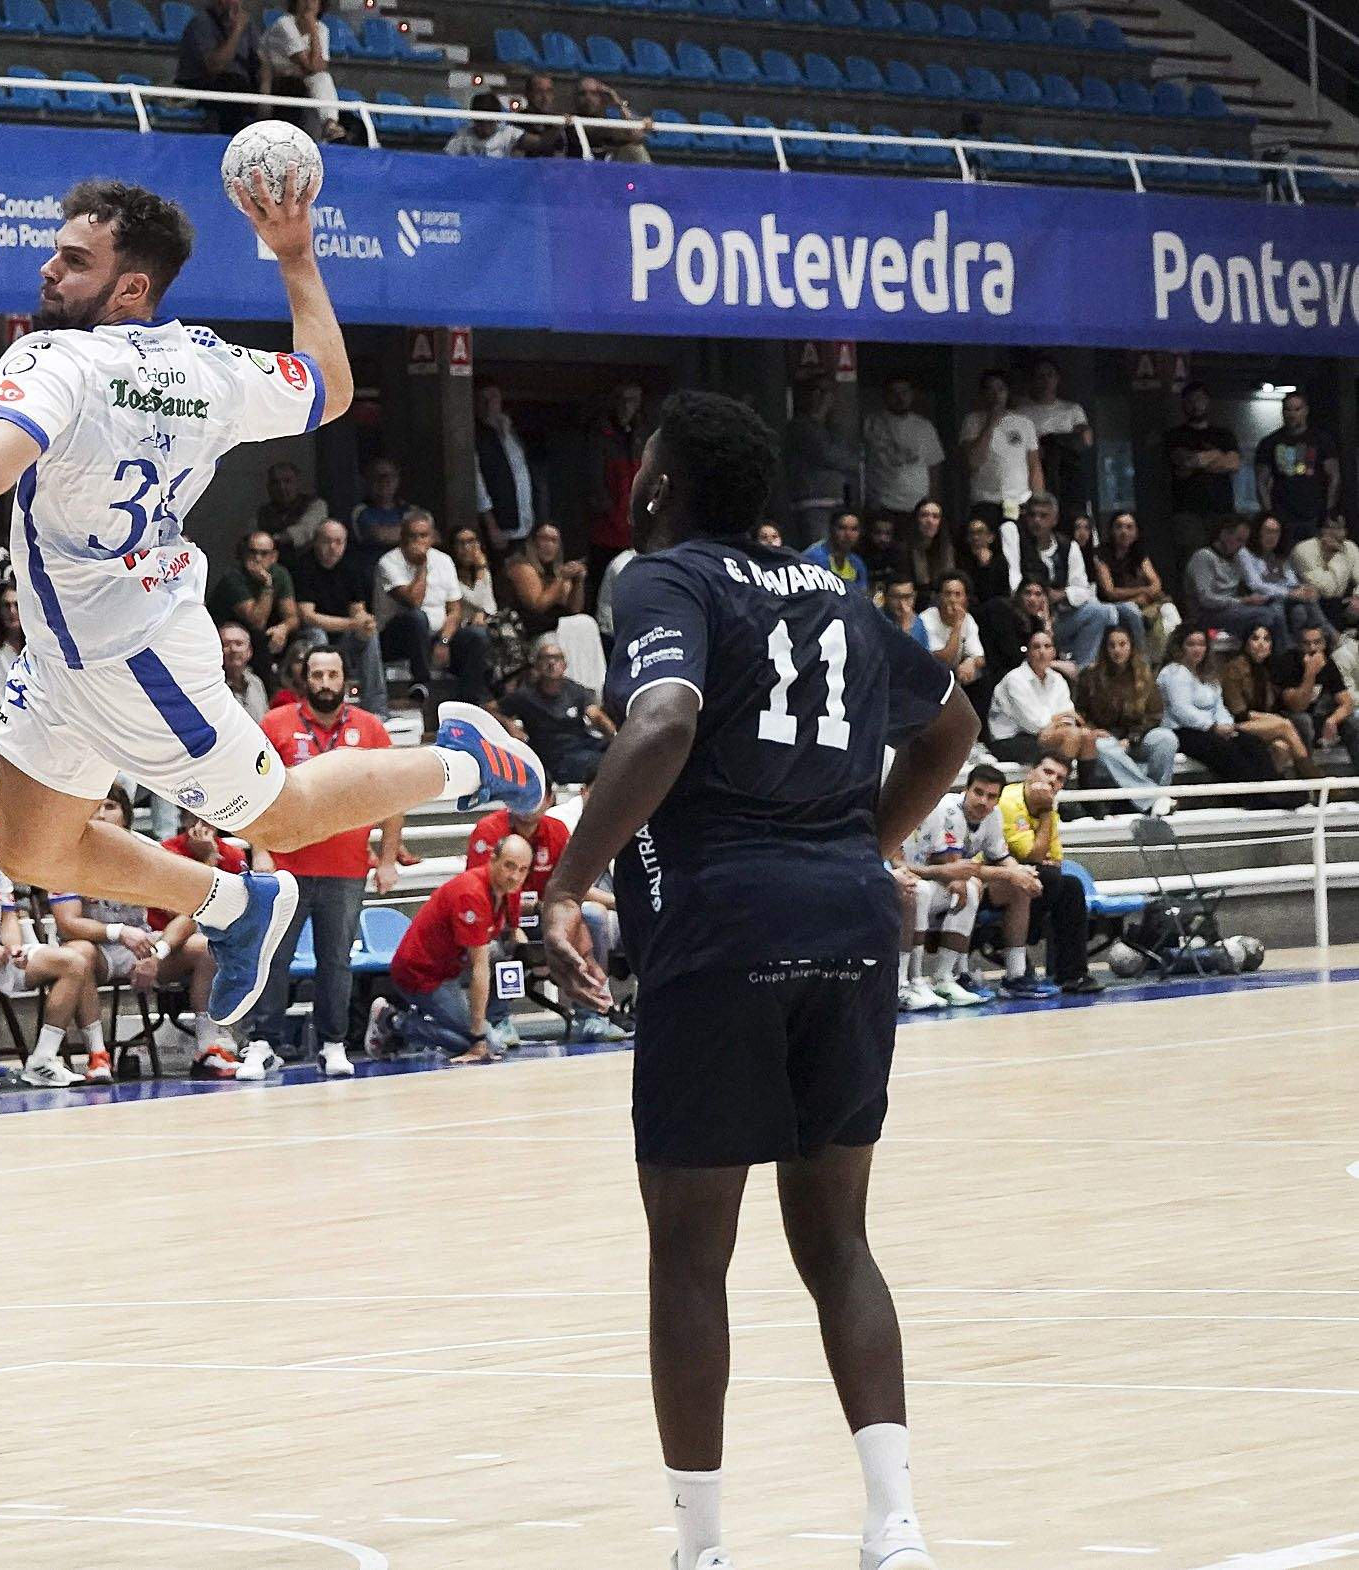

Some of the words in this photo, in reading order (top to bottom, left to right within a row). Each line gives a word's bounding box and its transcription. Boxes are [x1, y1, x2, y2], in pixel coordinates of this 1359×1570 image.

[311, 206, 347, 230] NTA
[313, 233, 384, 259] GALICIA
[629, 202, 1015, 315] Pontevedra
[1152, 230, 1359, 328] Pontev
[452, 334, 469, 361] A
[756, 617, 851, 752] 11
